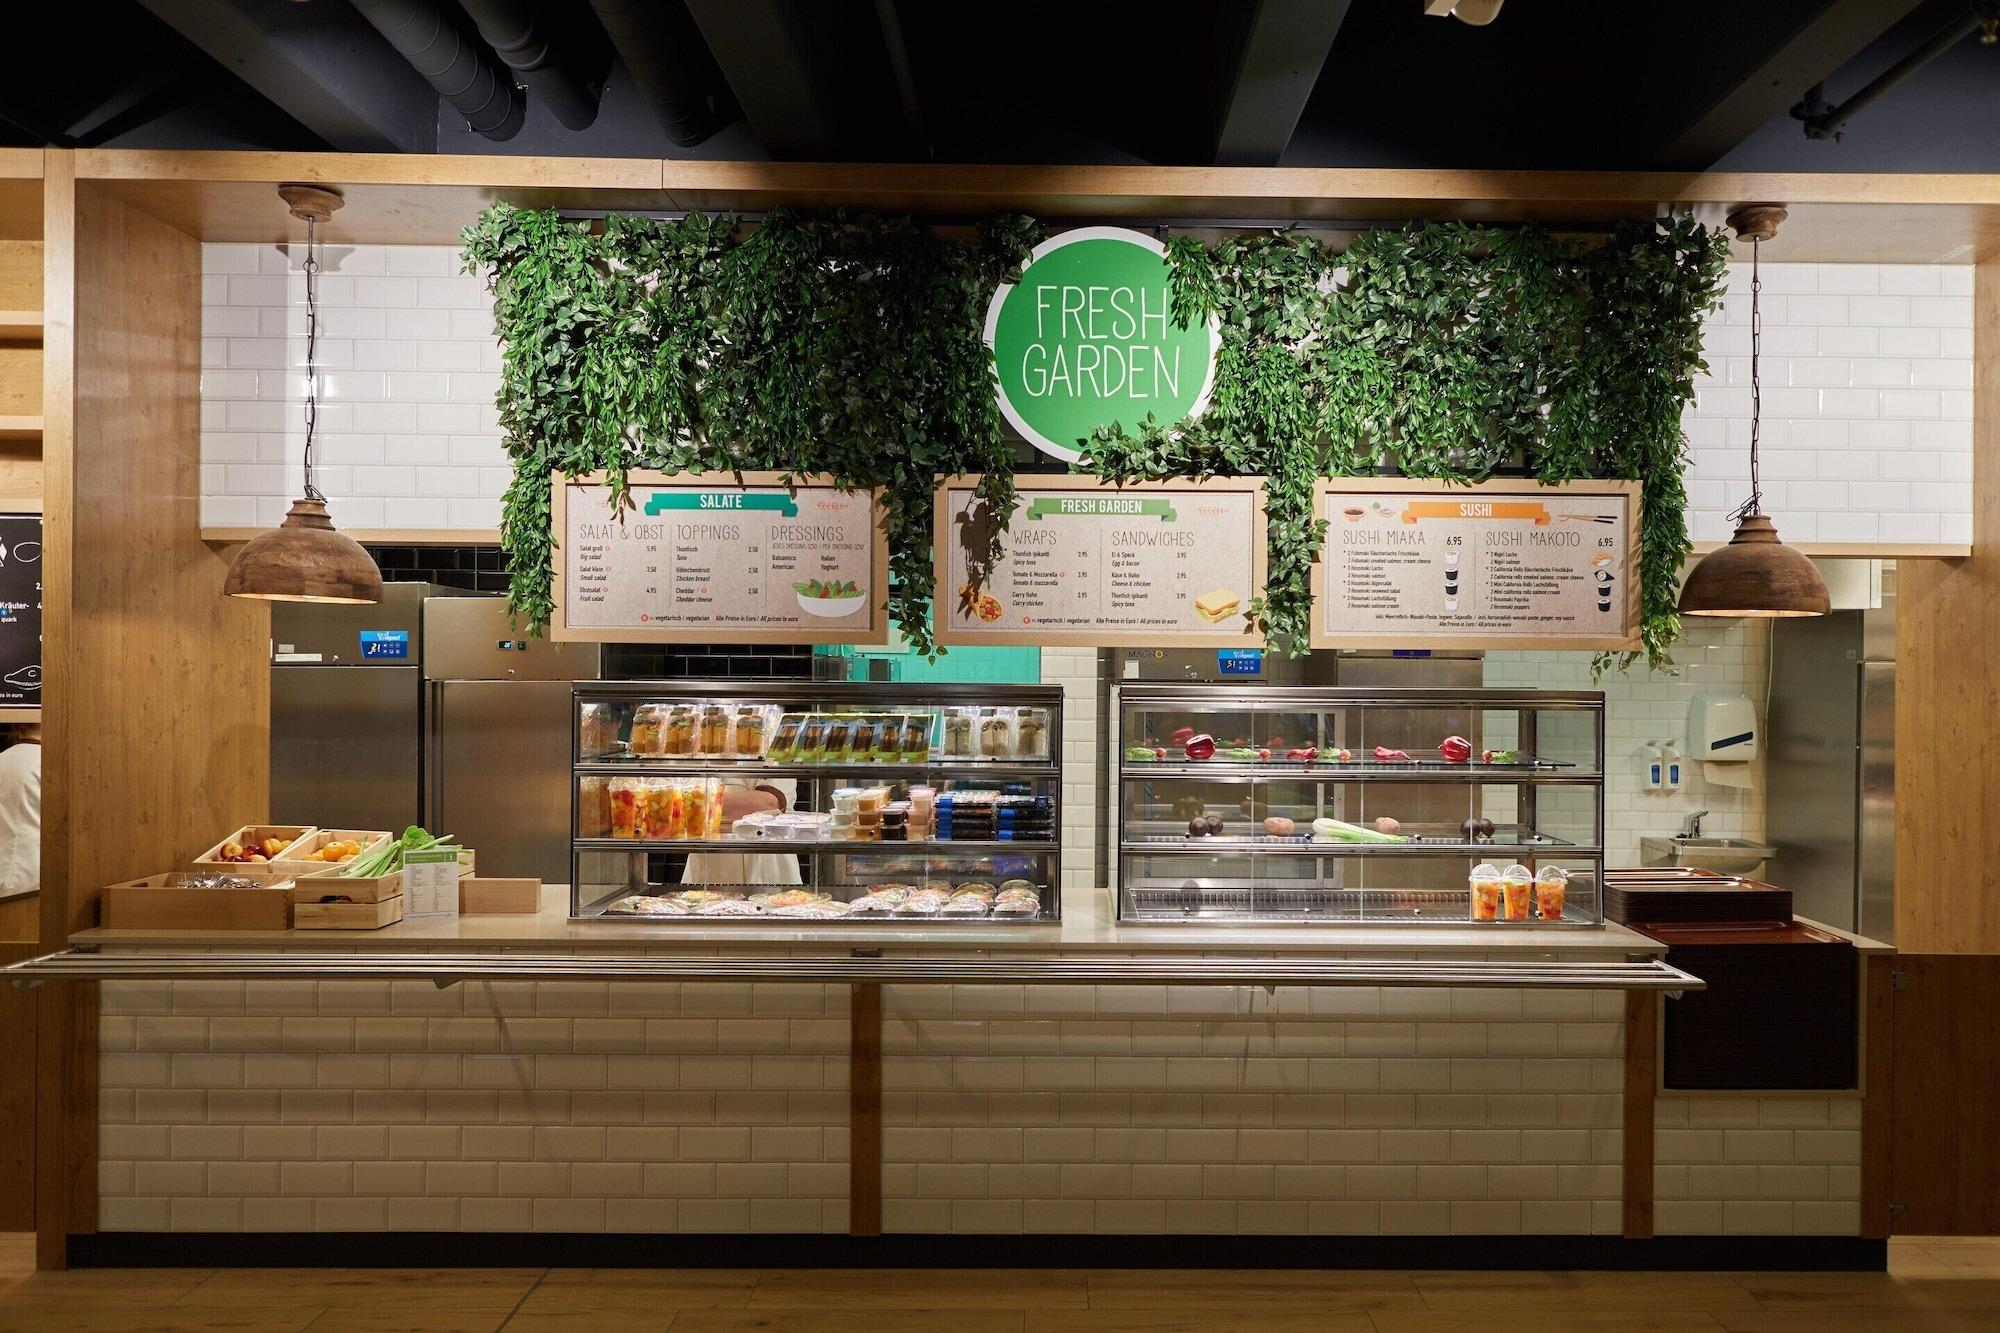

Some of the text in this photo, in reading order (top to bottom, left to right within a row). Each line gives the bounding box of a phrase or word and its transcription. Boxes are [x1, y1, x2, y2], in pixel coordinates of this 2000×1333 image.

[1037, 285, 1168, 340] FRESH
[1022, 343, 1181, 398] GARDEN
[700, 495, 743, 508] SALATE
[1061, 499, 1142, 513] FRESH GARDEN
[1460, 503, 1492, 517] SUSHI
[580, 524, 664, 540] SALAT & OBST
[676, 524, 740, 540] TOPPINGS
[771, 525, 844, 541] DRESSINGS
[1013, 530, 1057, 545] WRAPS
[1112, 531, 1195, 546] SANDWICHES
[1343, 529, 1380, 545] SUSHI
[1447, 536, 1462, 545] 6.95
[1486, 531, 1613, 547] SUSHI MAKOTO 6.95
